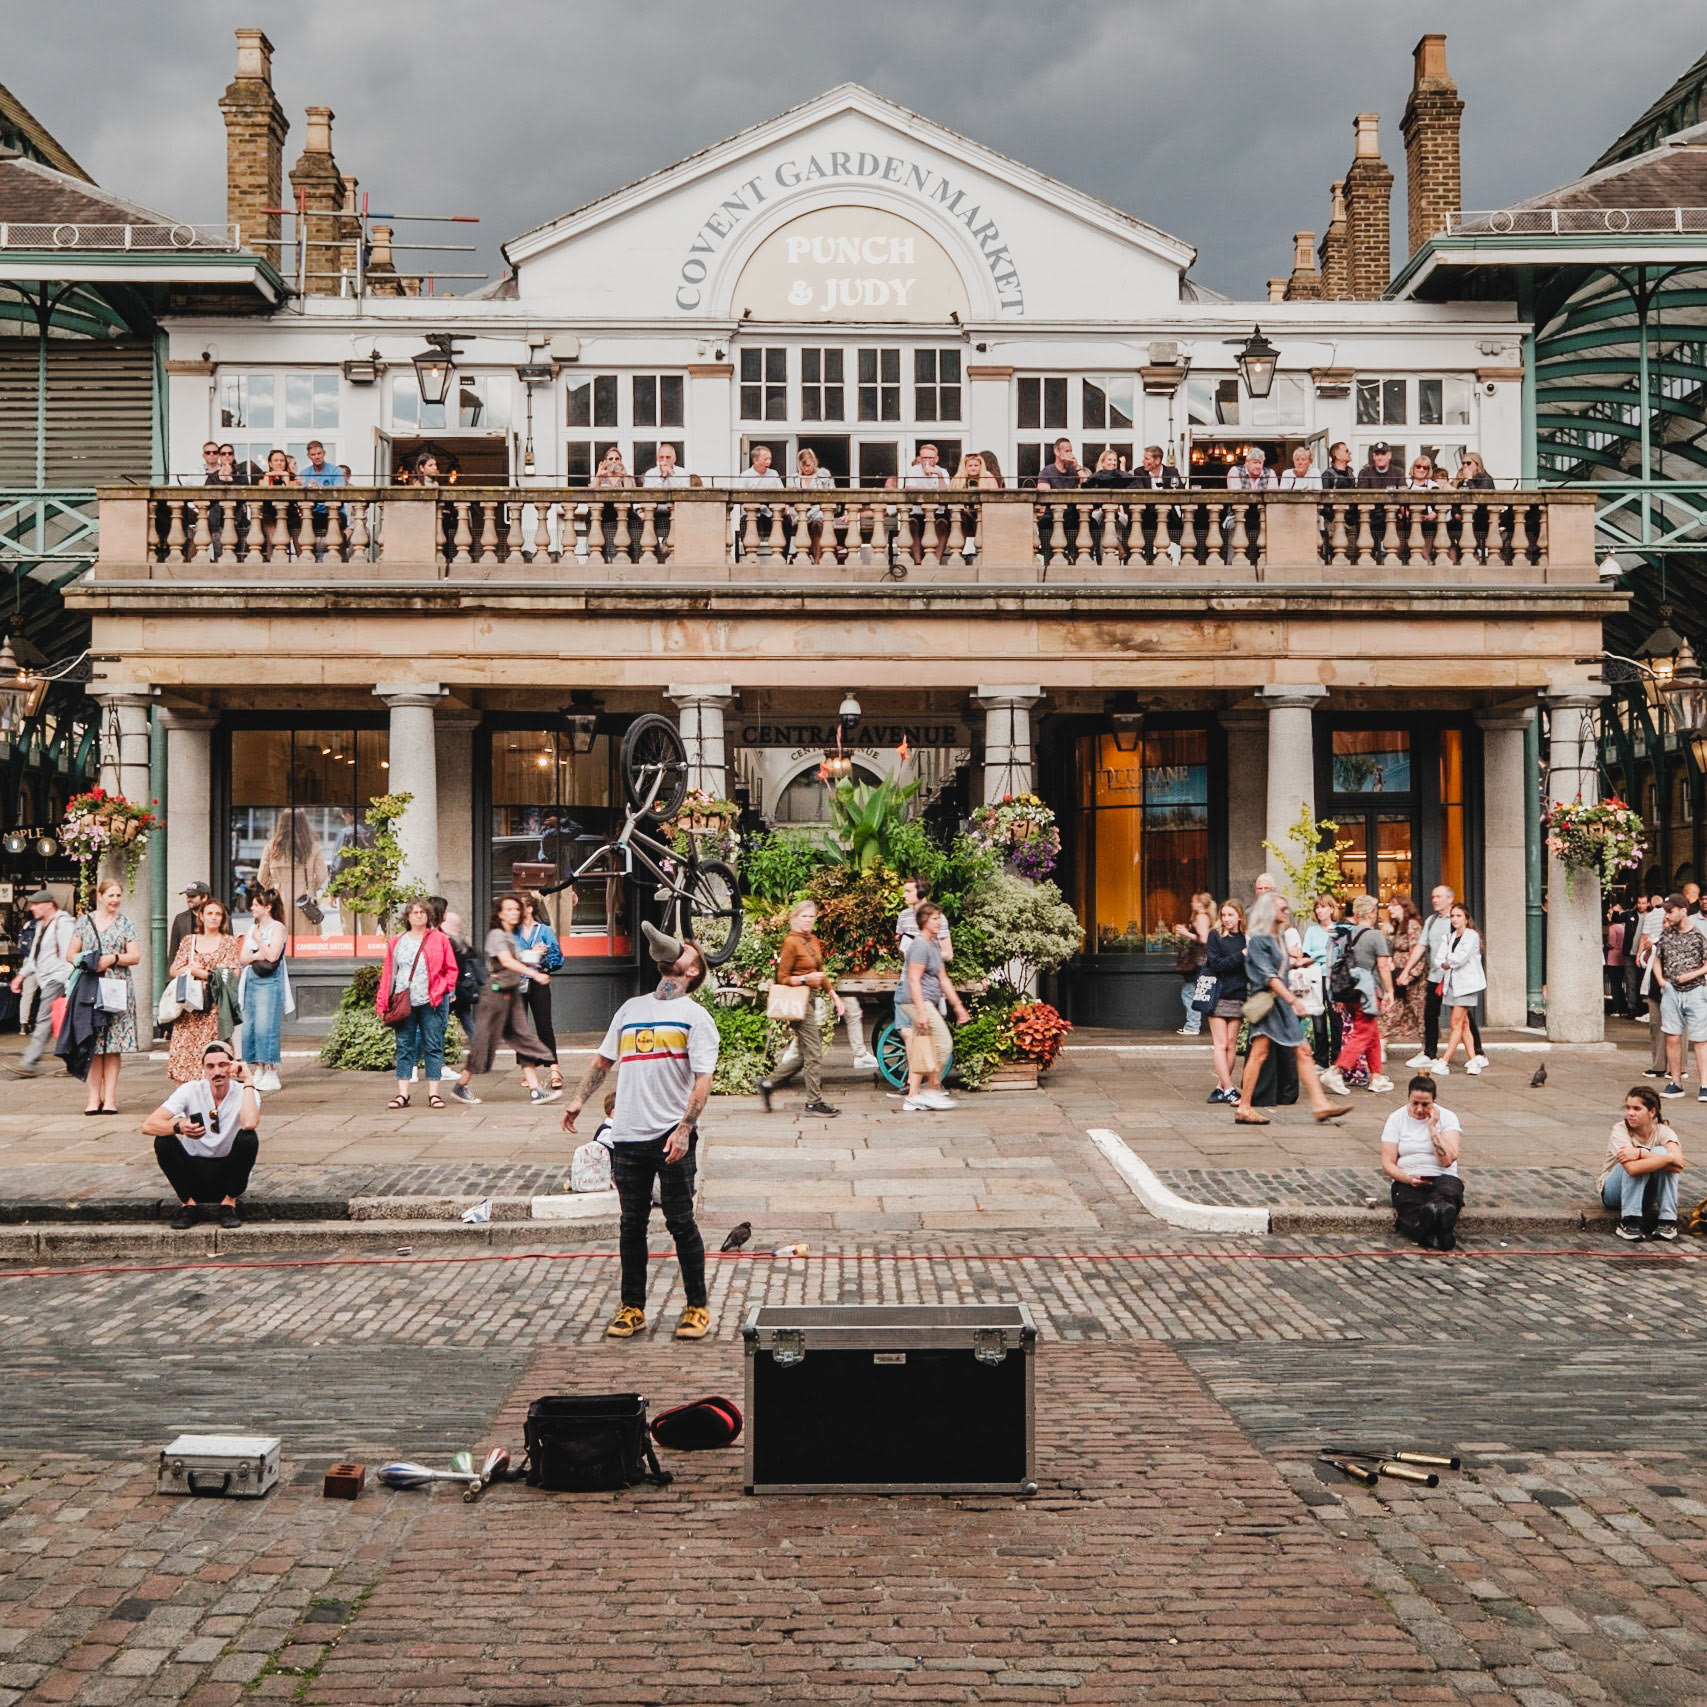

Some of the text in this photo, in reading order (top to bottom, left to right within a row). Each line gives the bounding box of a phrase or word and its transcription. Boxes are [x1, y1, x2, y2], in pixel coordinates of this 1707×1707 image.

[676, 152, 1024, 315] COVENT GARDEN MARKET
[785, 236, 915, 264] PUNCH
[787, 278, 916, 312] & JUDY
[742, 725, 956, 744] CENTRAL AVENUE
